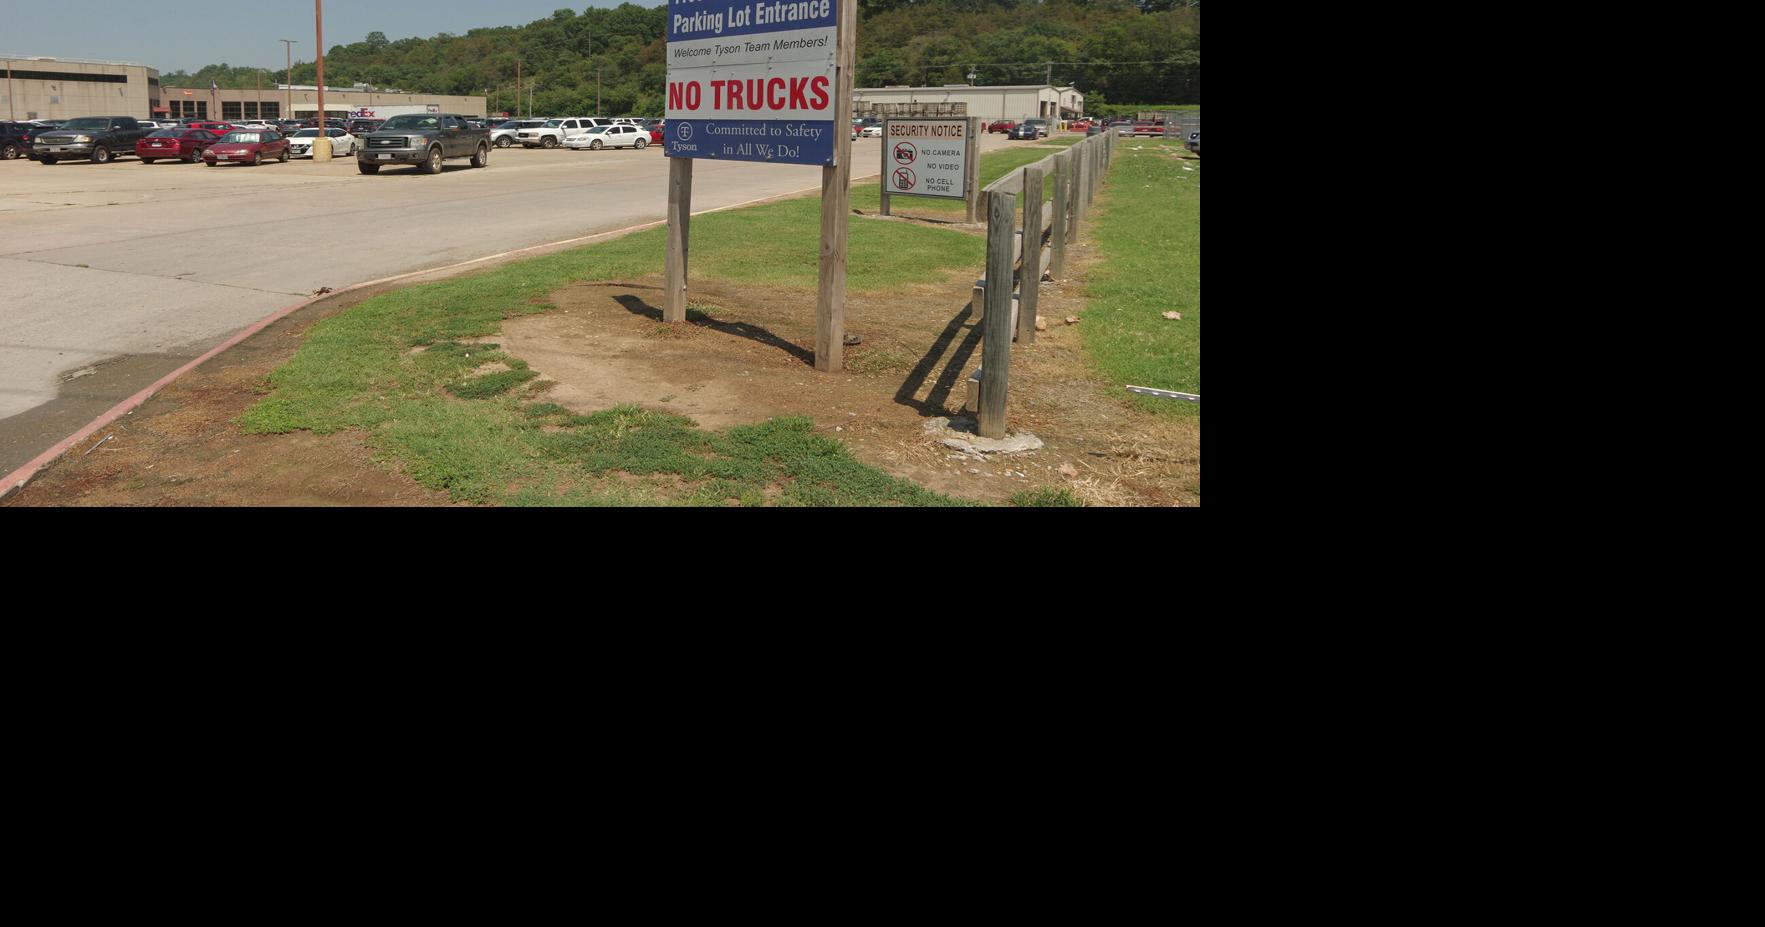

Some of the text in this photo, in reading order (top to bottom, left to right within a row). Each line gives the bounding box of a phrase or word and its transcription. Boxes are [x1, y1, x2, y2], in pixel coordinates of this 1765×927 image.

[673, 0, 830, 34] Parking Lot Entrance
[674, 35, 829, 58] Welcome Tyson Team Members!
[668, 75, 830, 111] NO TRUCKS
[705, 122, 823, 141] Committed to Safety
[890, 124, 963, 137] SECURITY NOTICE
[672, 140, 698, 152] Tyson
[723, 142, 800, 158] in All We Do!
[932, 149, 961, 157] CAMERA
[939, 163, 960, 171] VIDEO
[927, 184, 950, 192] PHONE
